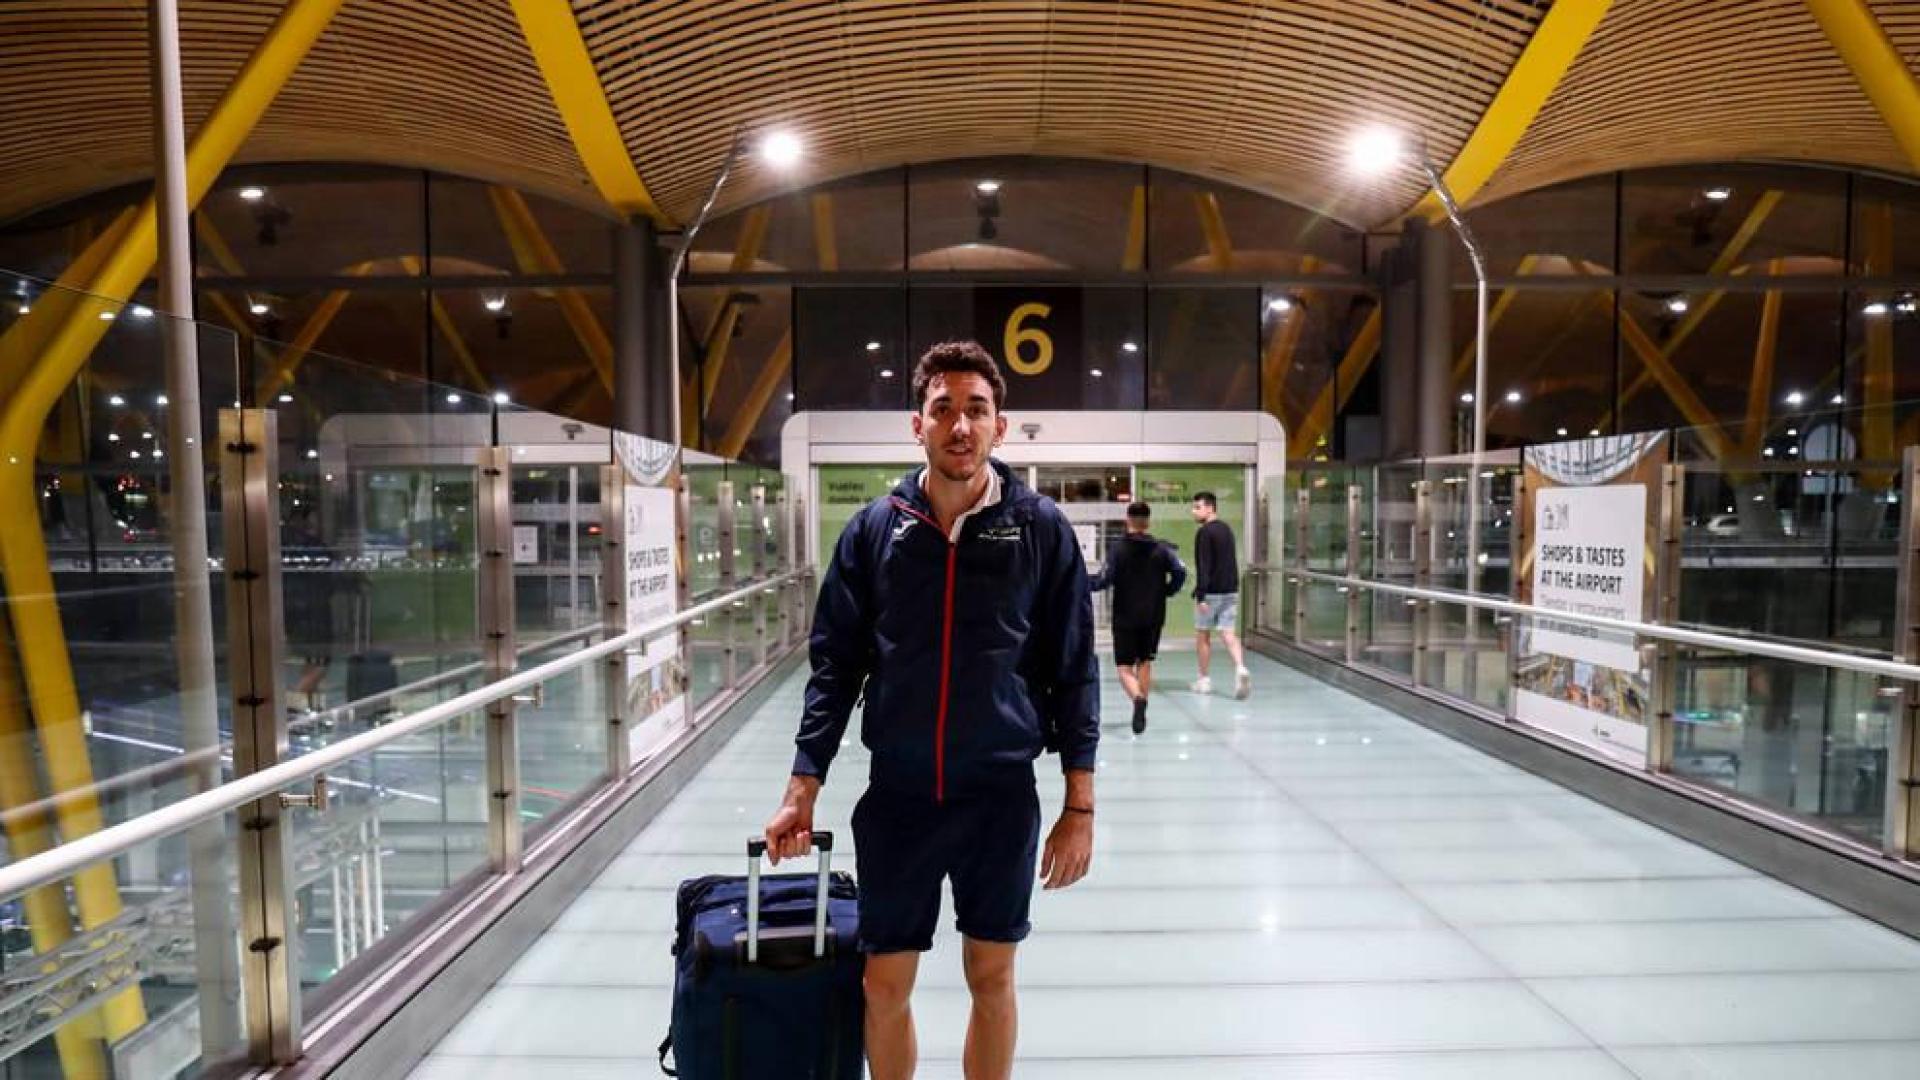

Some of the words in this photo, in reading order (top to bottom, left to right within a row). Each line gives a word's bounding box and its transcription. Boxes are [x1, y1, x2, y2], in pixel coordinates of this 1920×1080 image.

[1004, 303, 1052, 375] 6
[1541, 545, 1573, 563] SHOPS
[1576, 547, 1583, 564] &
[1586, 547, 1625, 567] TASTES
[1541, 570, 1552, 585] AT
[1555, 570, 1573, 589] THE
[1576, 573, 1622, 595] AIRPORT
